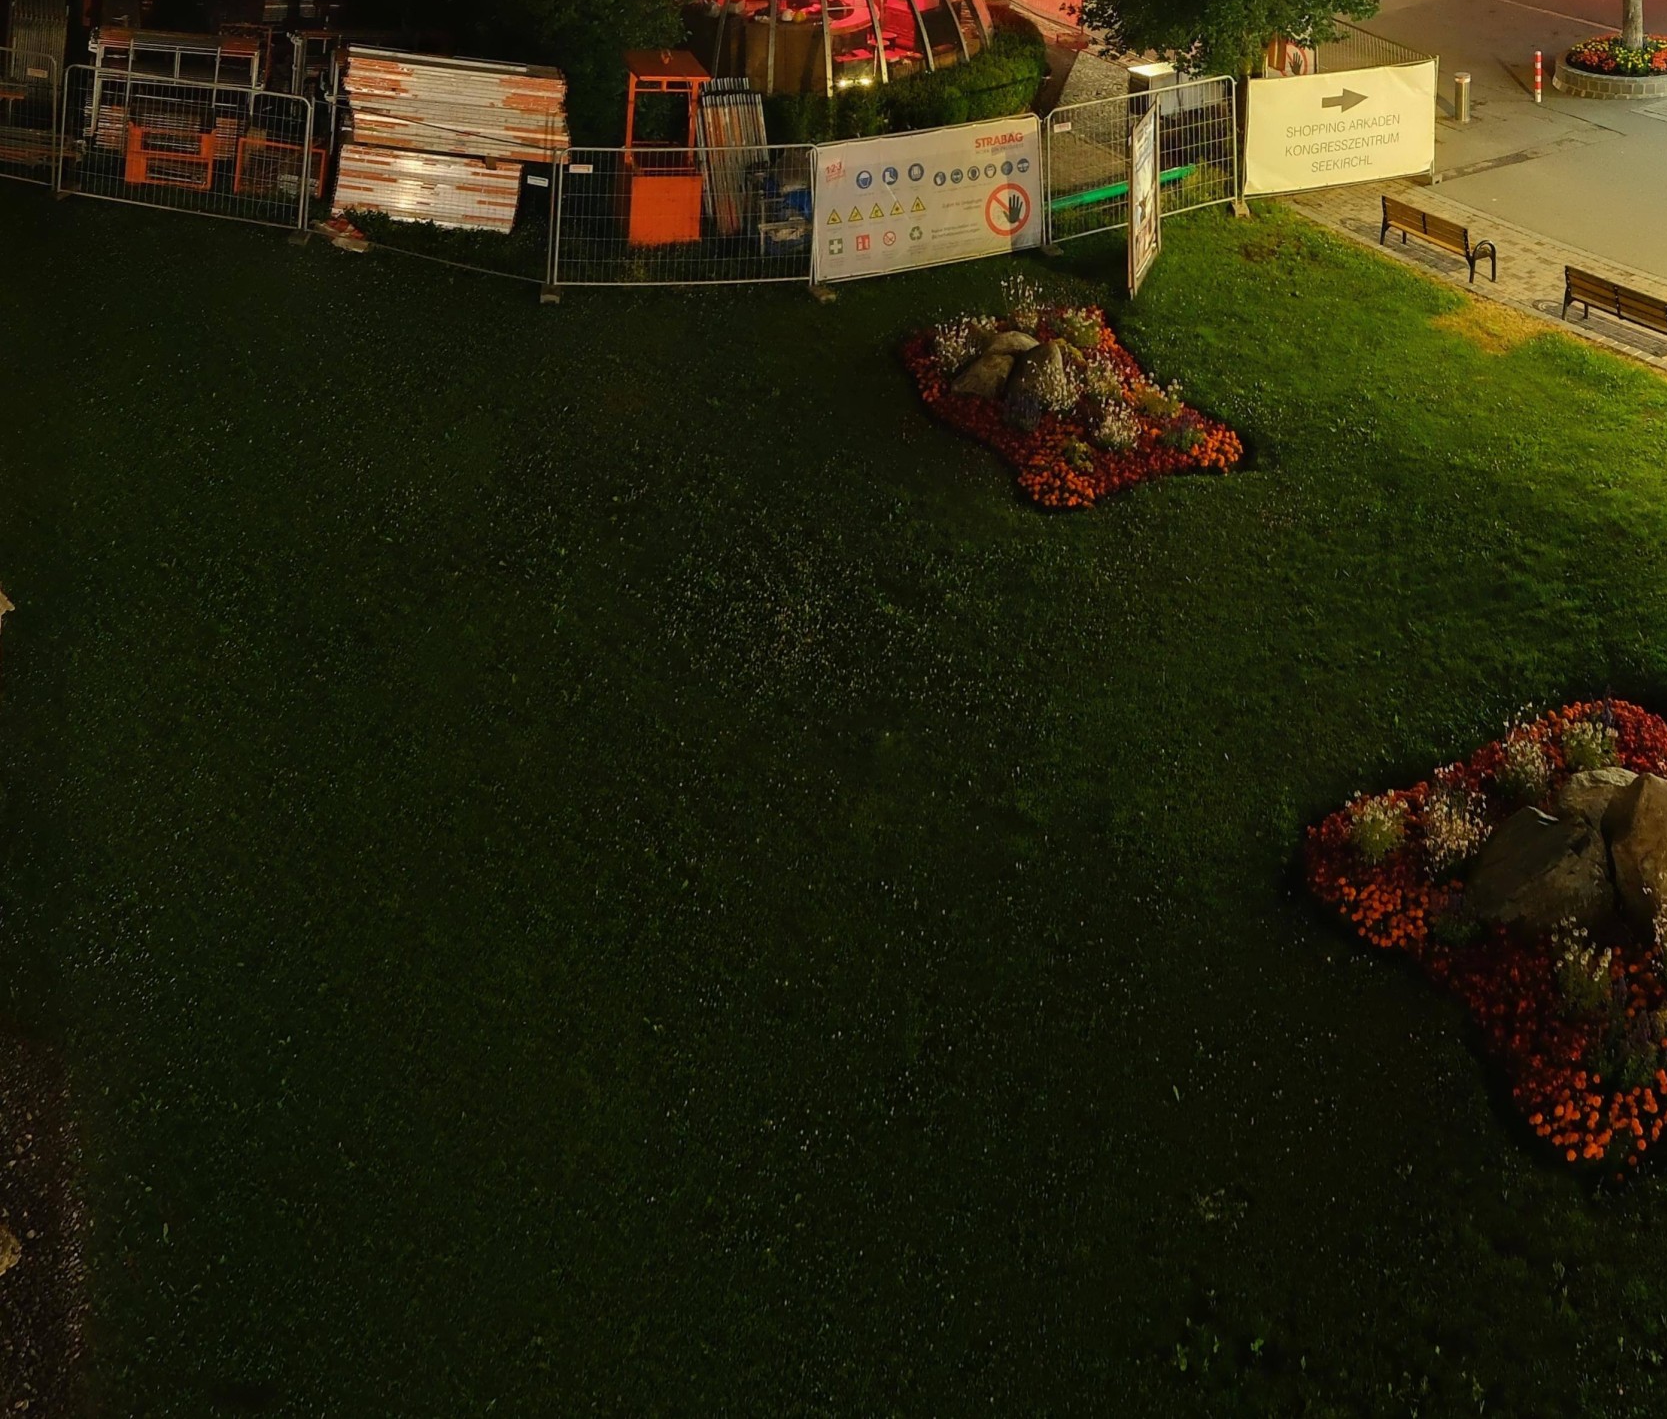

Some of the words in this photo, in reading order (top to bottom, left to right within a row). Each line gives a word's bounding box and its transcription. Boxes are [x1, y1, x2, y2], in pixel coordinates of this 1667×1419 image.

[1286, 120, 1346, 138] SHOPPING
[1349, 114, 1400, 131] ARKADEN
[975, 132, 1024, 149] STRABAG
[1285, 132, 1400, 157] KONGRESSZENTRUM
[1311, 154, 1373, 173] SEEKIRCHL
